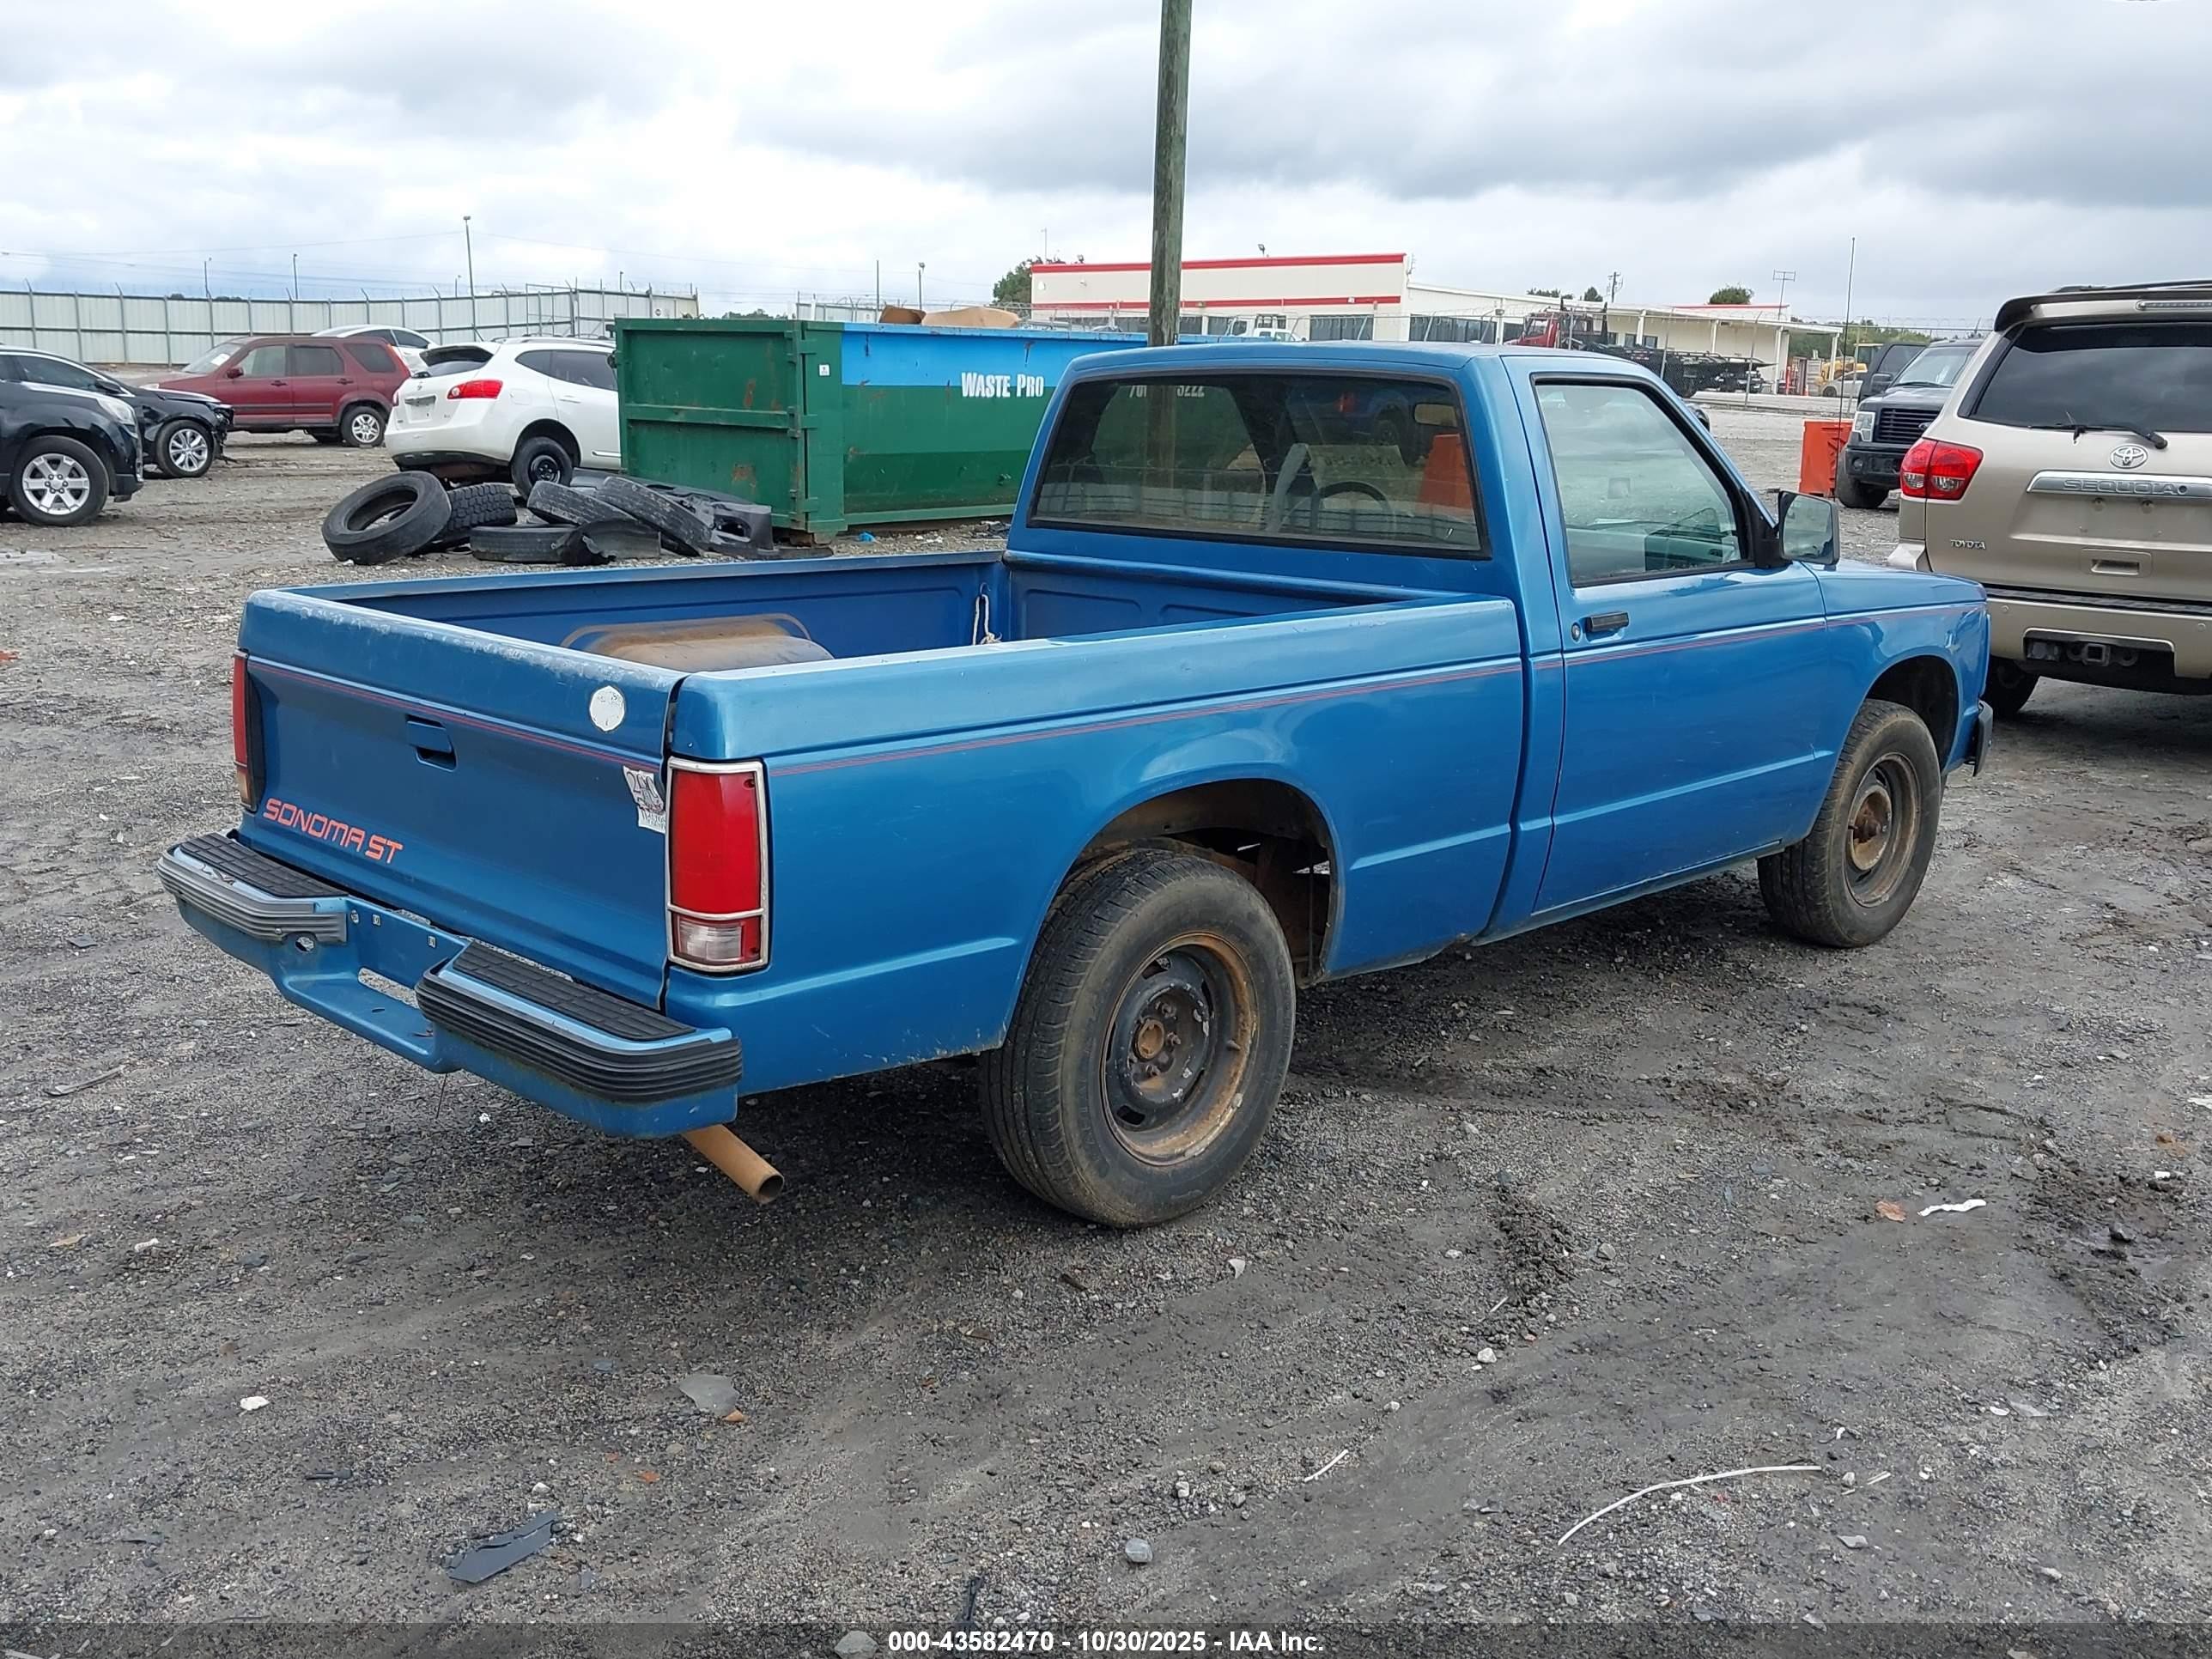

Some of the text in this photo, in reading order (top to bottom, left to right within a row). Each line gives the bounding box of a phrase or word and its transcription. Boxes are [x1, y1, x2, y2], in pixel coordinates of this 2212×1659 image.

[2063, 478, 2179, 495] SEQUOIA
[1950, 539, 1986, 550] TOYOTA
[263, 797, 404, 864] SONOMA ST
